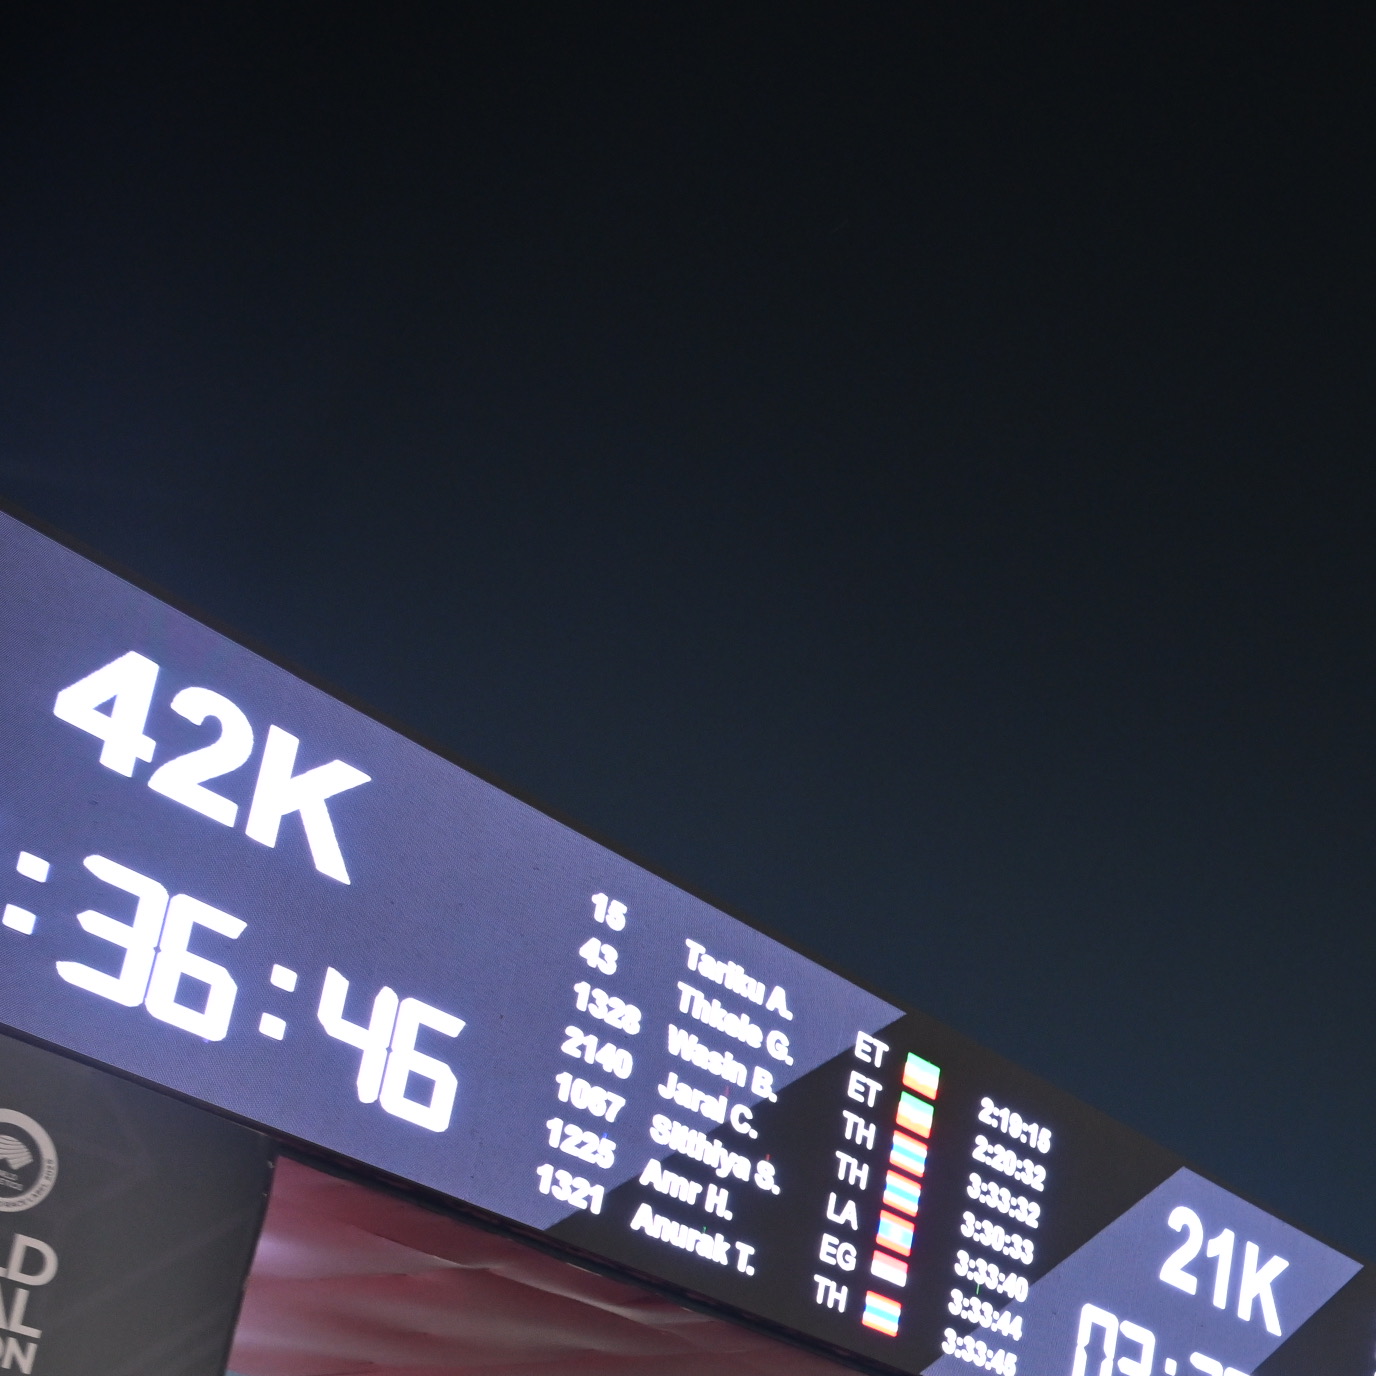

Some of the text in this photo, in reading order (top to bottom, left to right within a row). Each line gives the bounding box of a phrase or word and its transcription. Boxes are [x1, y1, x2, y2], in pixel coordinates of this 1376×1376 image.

[53, 650, 372, 885] 42K
[578, 937, 619, 976] 43
[766, 1030, 794, 1066] G.
[847, 1070, 883, 1108] ET
[591, 892, 628, 932] 15
[765, 985, 794, 1021] A.
[854, 1030, 890, 1068] ET
[560, 1025, 634, 1080] 2140
[730, 1103, 758, 1139] C.
[835, 1150, 869, 1191] TH
[751, 1065, 778, 1103] B.
[842, 1109, 876, 1150] TH
[536, 1163, 605, 1215] 1321
[735, 1241, 755, 1276] T.
[813, 1274, 848, 1313] TH
[546, 1117, 617, 1169] 1225
[638, 1158, 703, 1205] Amr
[704, 1183, 733, 1221] H.
[819, 1233, 857, 1271] EG
[754, 1160, 781, 1195] S.
[826, 1192, 858, 1231] LA
[1159, 1205, 1290, 1337] 21K
